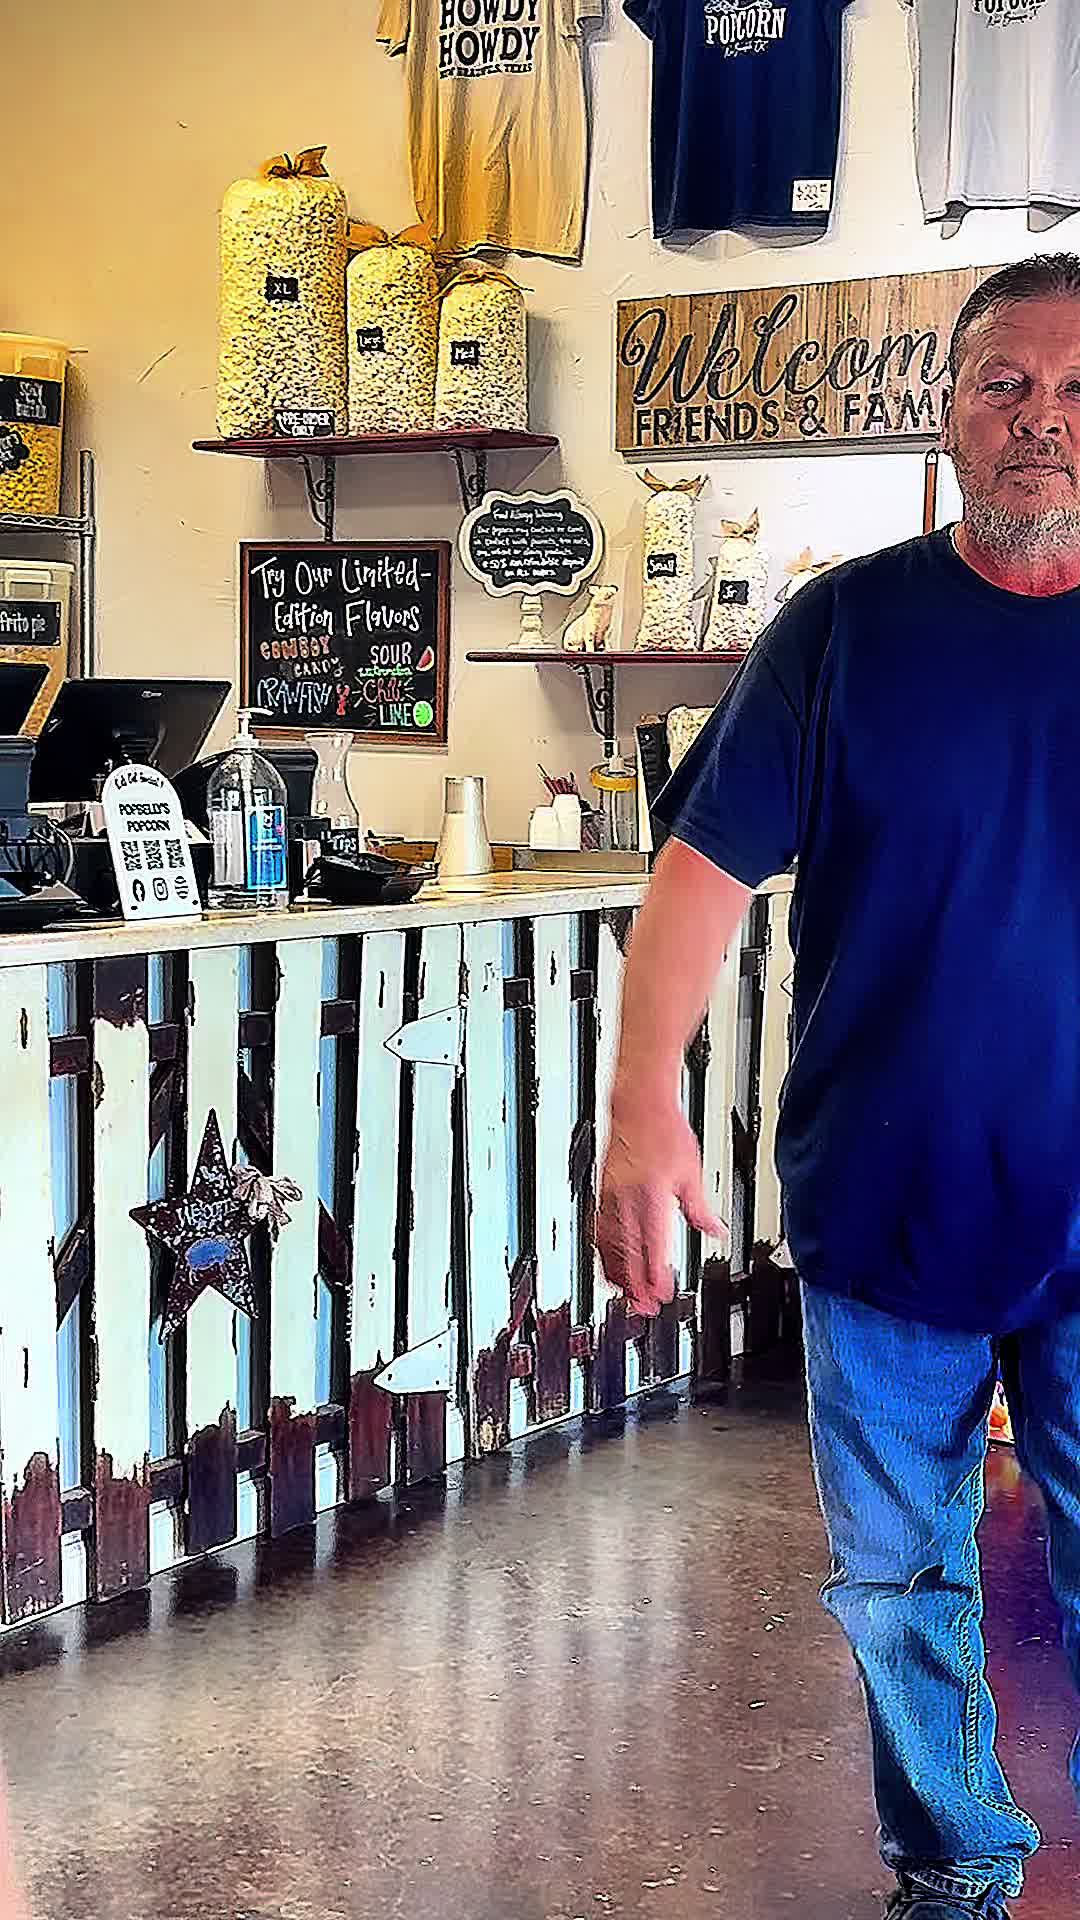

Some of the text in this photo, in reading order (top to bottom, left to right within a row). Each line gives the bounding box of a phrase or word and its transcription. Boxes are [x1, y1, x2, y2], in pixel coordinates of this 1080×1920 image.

[439, 0, 537, 30] HOWDY
[439, 27, 540, 68] HOWDY
[273, 282, 292, 295] XL
[620, 294, 952, 404] Welcom
[635, 400, 780, 446] FRIENDS
[799, 395, 829, 436] &
[250, 556, 285, 599] Try
[295, 561, 333, 595] Our
[274, 600, 420, 636] Edition Flavors
[370, 641, 413, 665] SOUR
[379, 702, 413, 727] LIME
[127, 819, 171, 833] POPCORN
